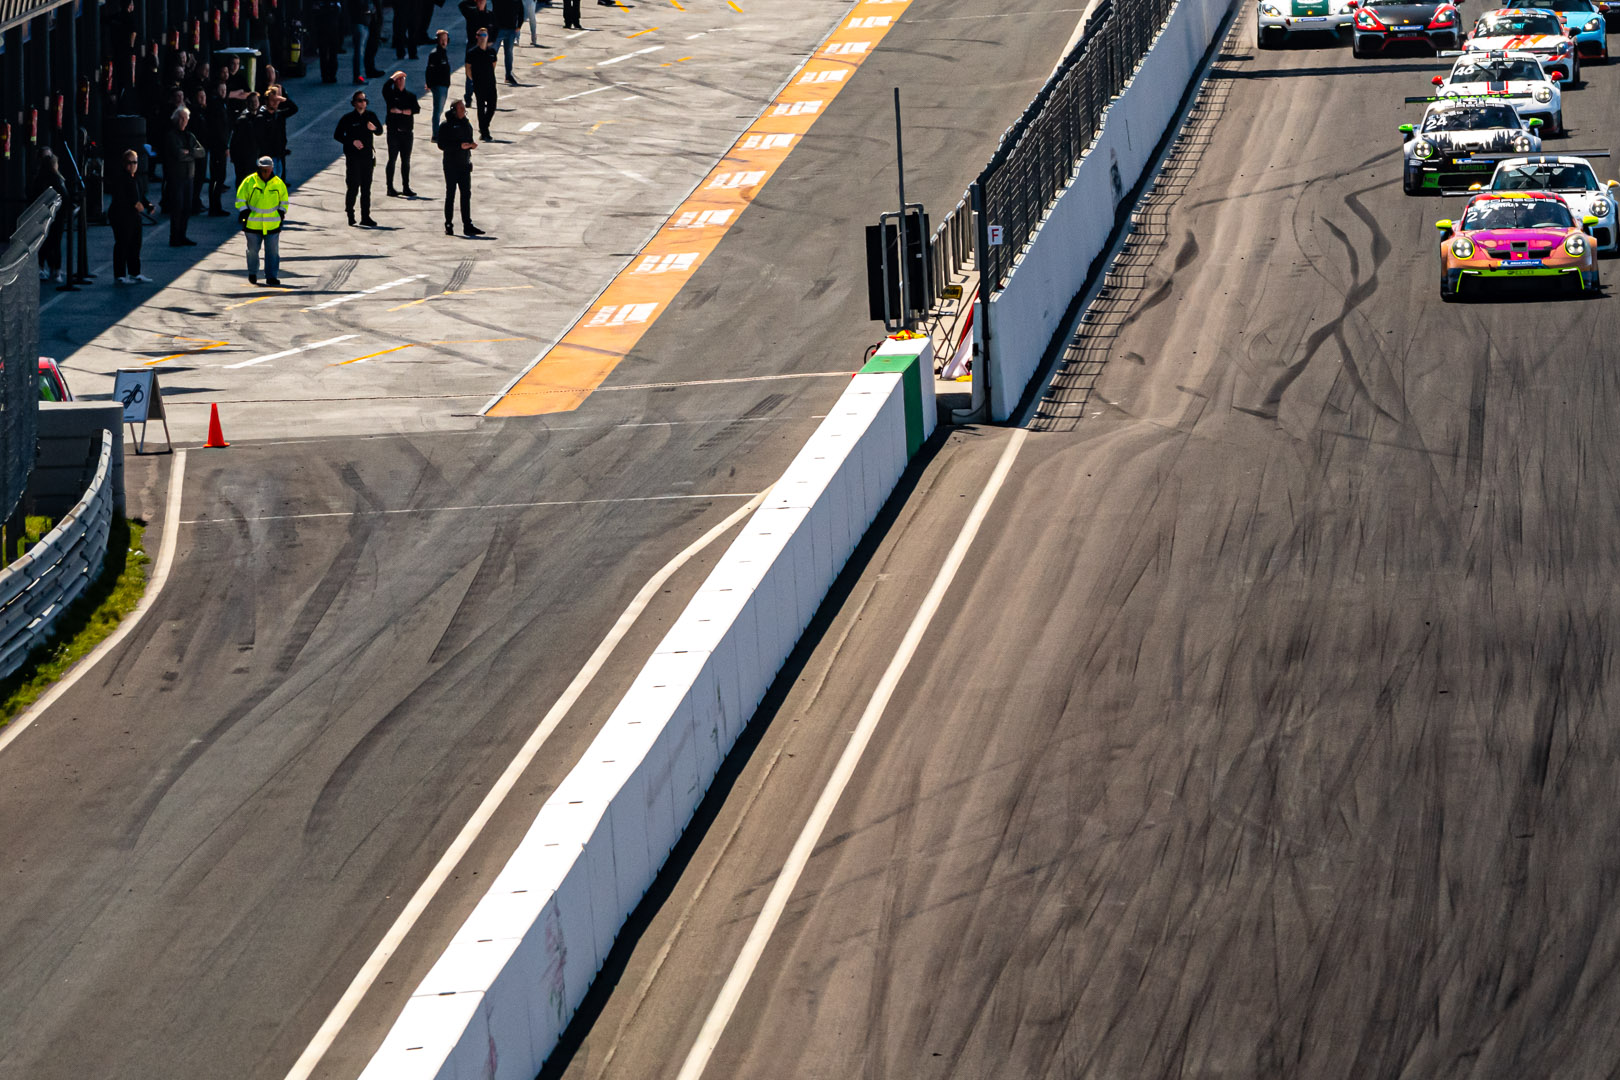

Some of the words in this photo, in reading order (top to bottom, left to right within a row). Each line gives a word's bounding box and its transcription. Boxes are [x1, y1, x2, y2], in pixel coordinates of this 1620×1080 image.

[1453, 65, 1475, 77] 46
[1425, 115, 1448, 131] 24
[1466, 208, 1493, 224] 27
[992, 228, 1000, 242] F
